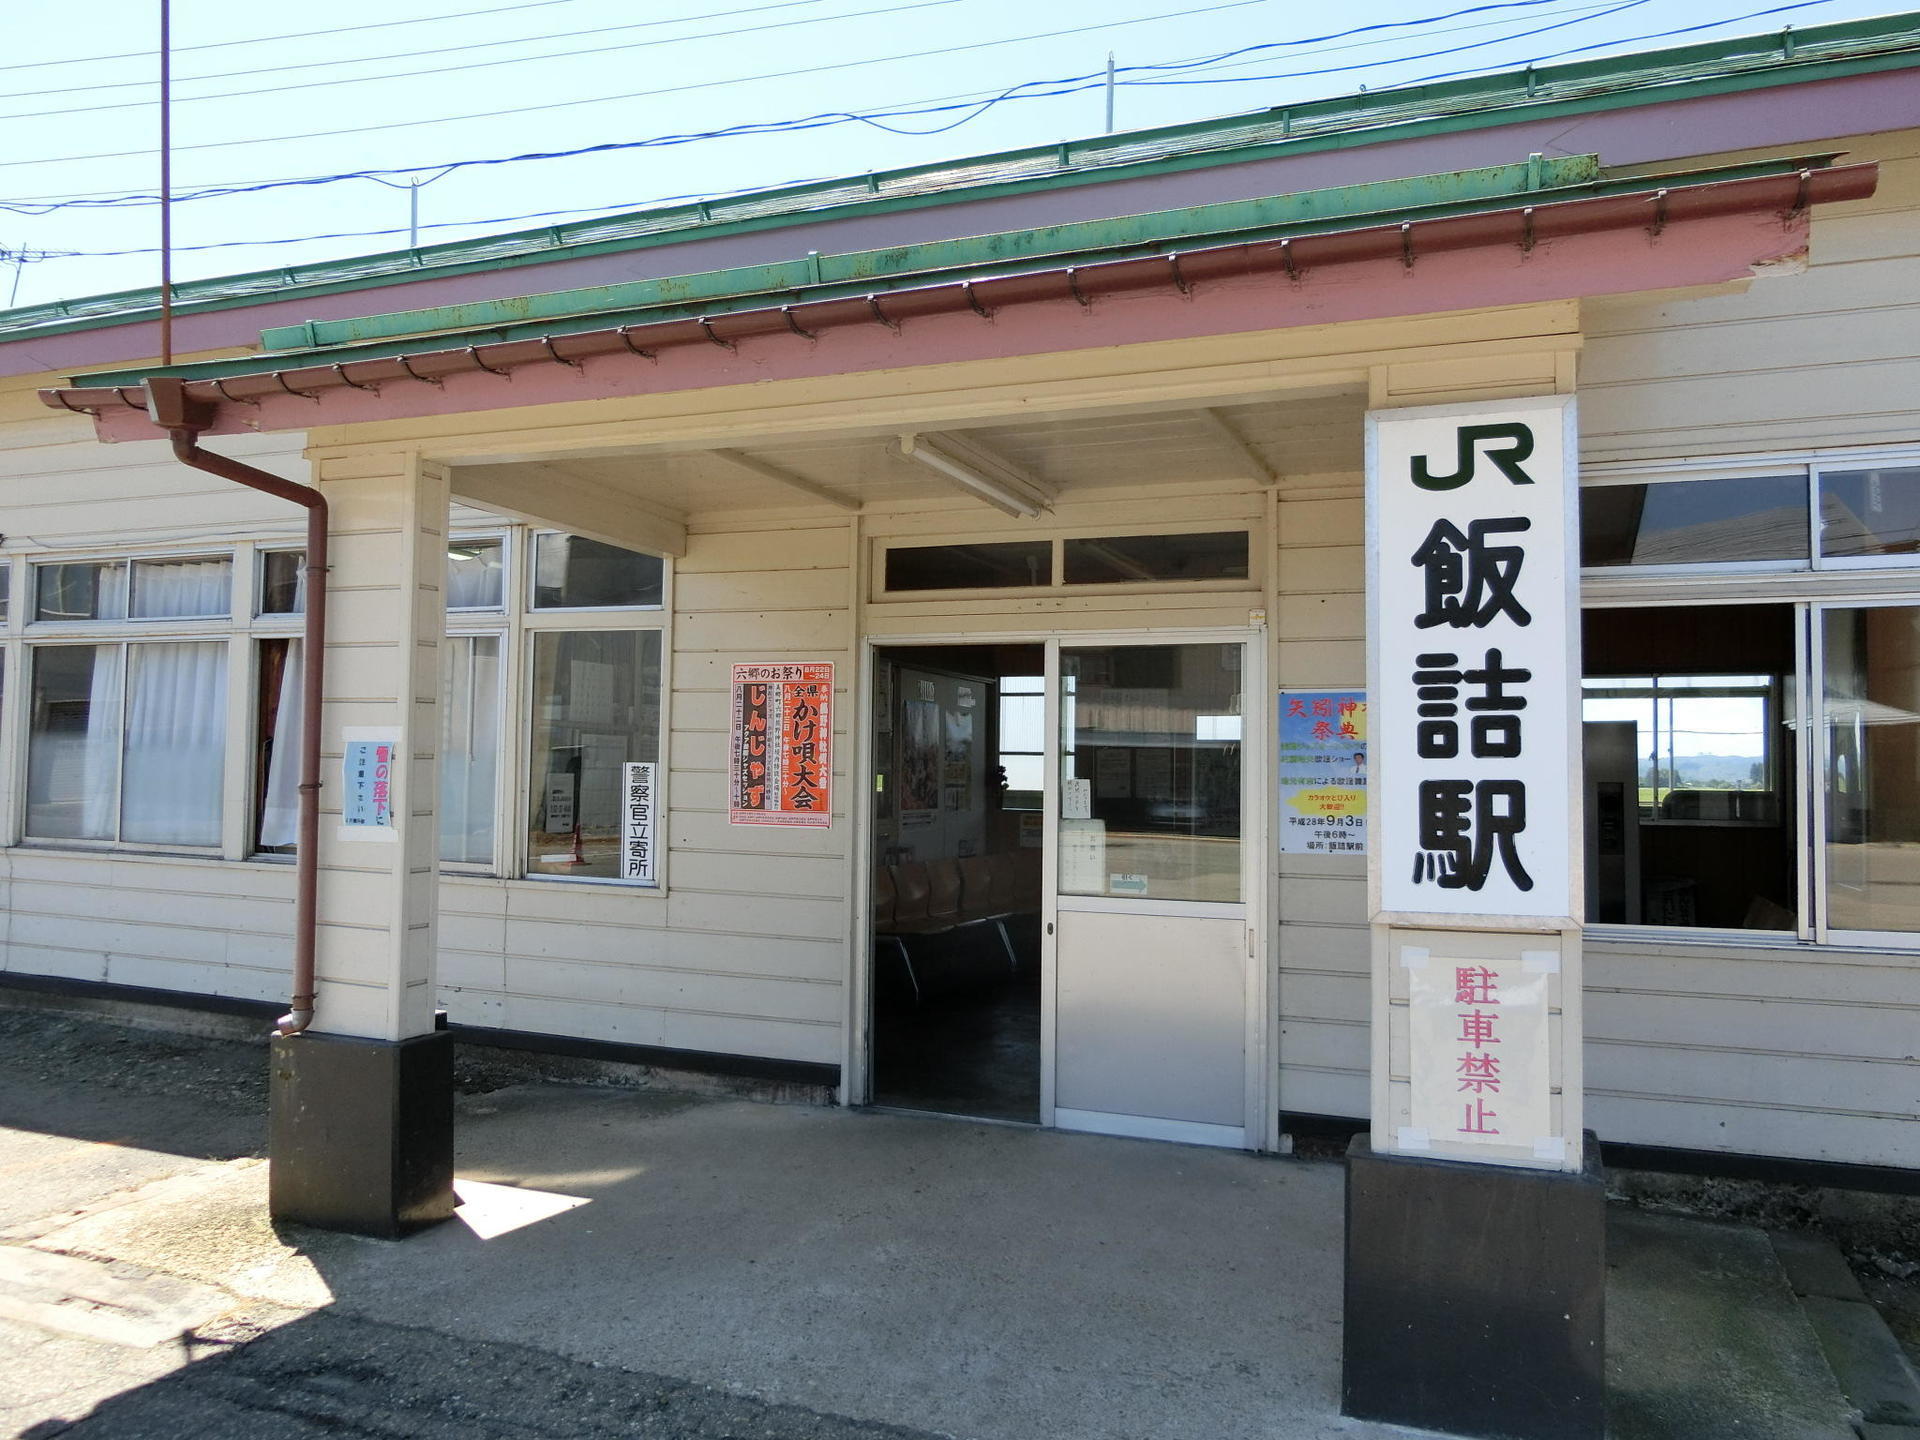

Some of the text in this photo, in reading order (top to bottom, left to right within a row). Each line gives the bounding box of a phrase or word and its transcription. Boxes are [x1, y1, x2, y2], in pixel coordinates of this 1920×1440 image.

[1411, 422, 1535, 491] JR
[735, 666, 803, 680] 六郷のお祭り
[1411, 516, 1533, 892] 飯詰駅
[734, 685, 743, 731] 八月二十二日
[1311, 720, 1359, 740] 祭典
[747, 685, 767, 807] じんじゃず
[790, 698, 820, 810] かけ唄大会
[628, 765, 650, 877] 警察官立寄所
[1288, 815, 1364, 827] 平成28年9月3日
[1307, 794, 1357, 802] カラオケとび入り
[1455, 965, 1501, 1135] 駐車禁止
